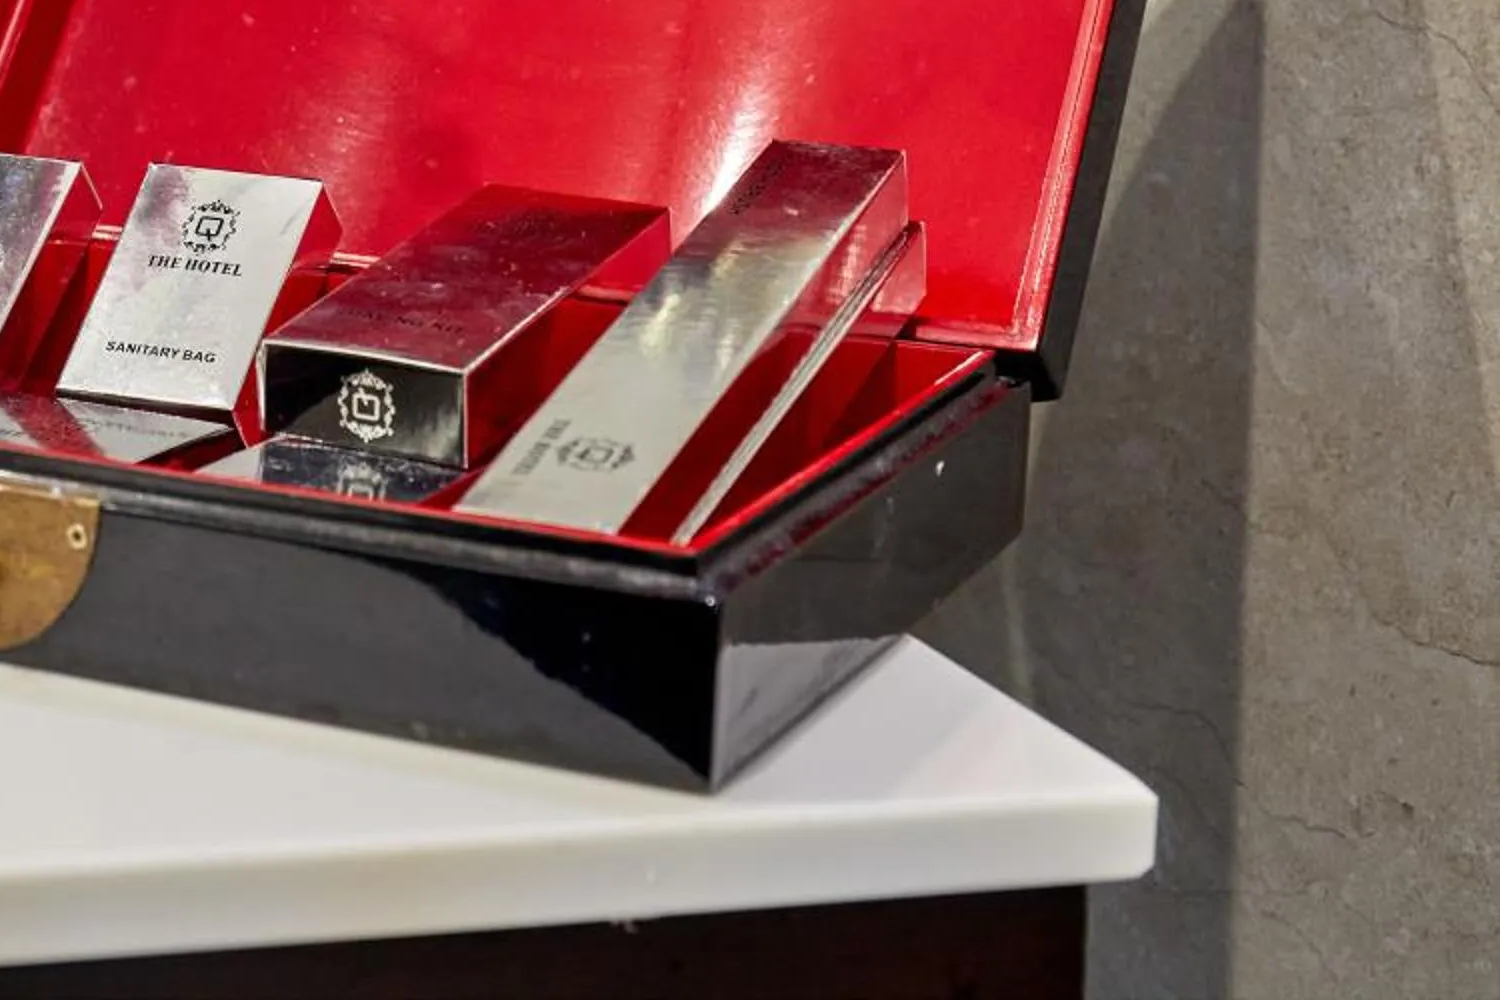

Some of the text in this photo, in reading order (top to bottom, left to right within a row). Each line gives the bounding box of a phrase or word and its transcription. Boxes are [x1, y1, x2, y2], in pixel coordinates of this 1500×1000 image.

[148, 255, 243, 277] THE HOTEL
[105, 341, 218, 363] SANITARY BAG
